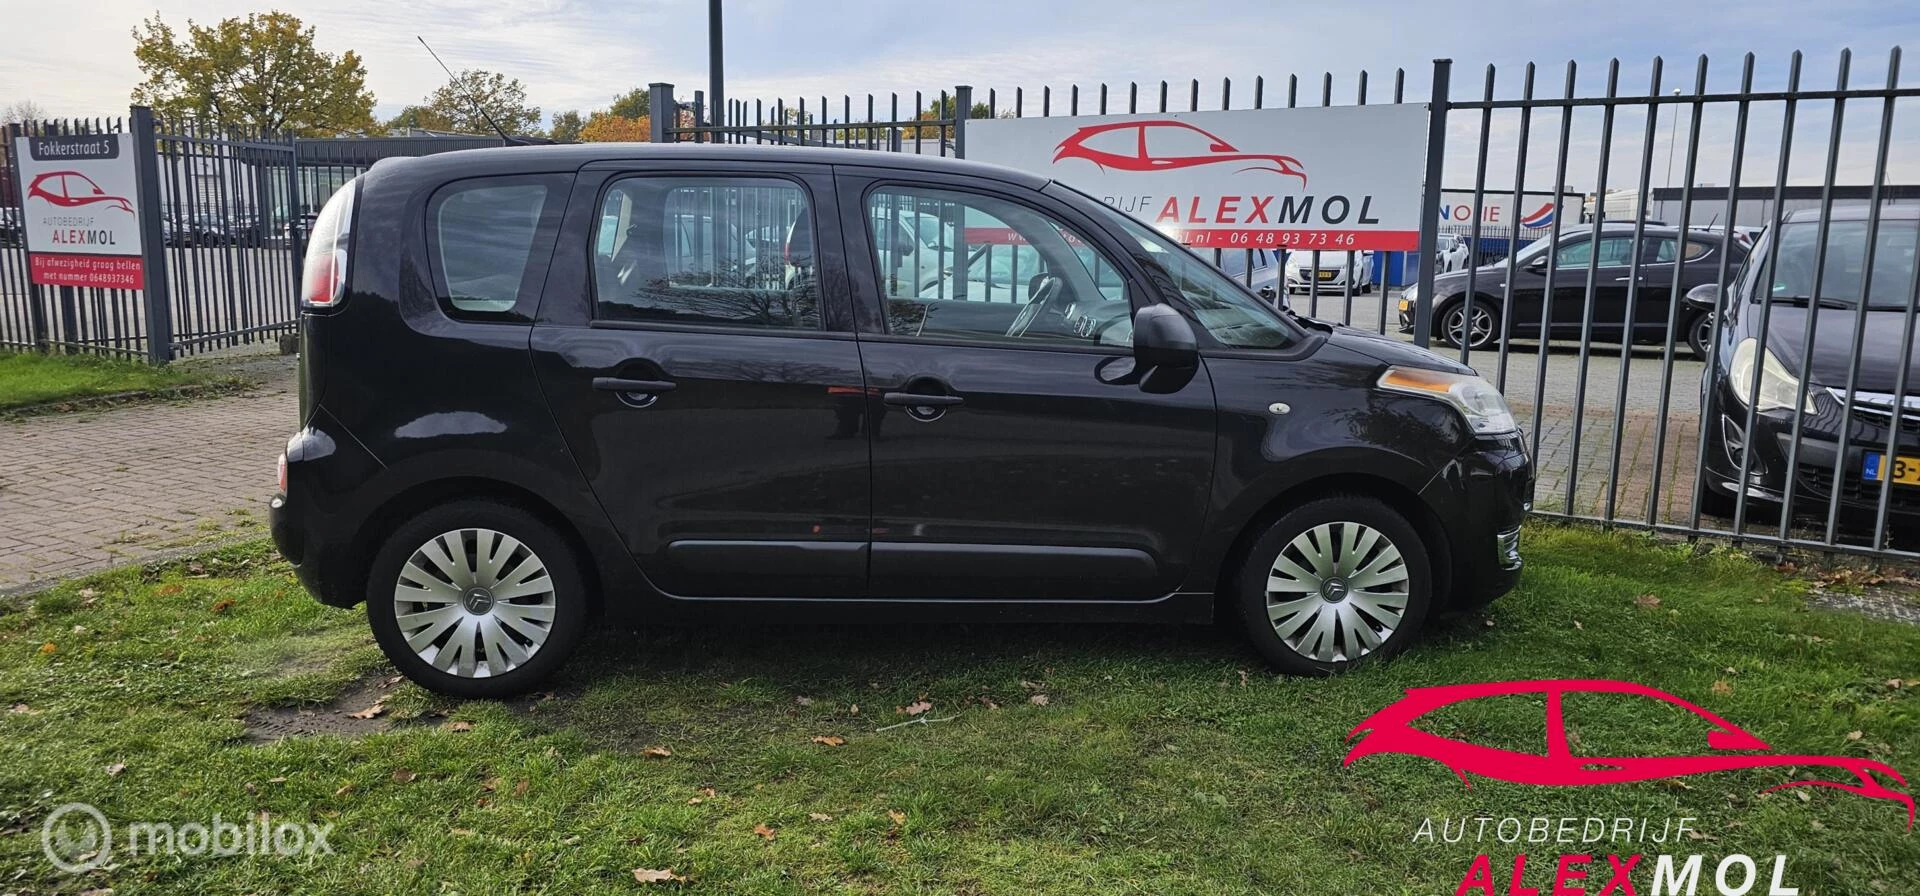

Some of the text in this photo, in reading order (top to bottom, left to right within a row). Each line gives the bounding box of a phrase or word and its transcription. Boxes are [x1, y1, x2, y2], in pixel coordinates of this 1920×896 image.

[39, 140, 110, 156] Fokkerstraat 5
[1156, 195, 1379, 224] ALEXMOL
[43, 216, 94, 227] AUTOBEDRIJF
[52, 229, 116, 245] ALEXMOL
[1231, 232, 1248, 244] 06
[1256, 233, 1274, 245] 48
[1282, 233, 1300, 245] 93
[1308, 234, 1326, 245] 73
[1335, 234, 1355, 245] 46
[35, 257, 141, 271] Bij afwezigheid graag bellen
[43, 271, 134, 284] met nummer 0648937346
[1865, 468, 1877, 476] NL
